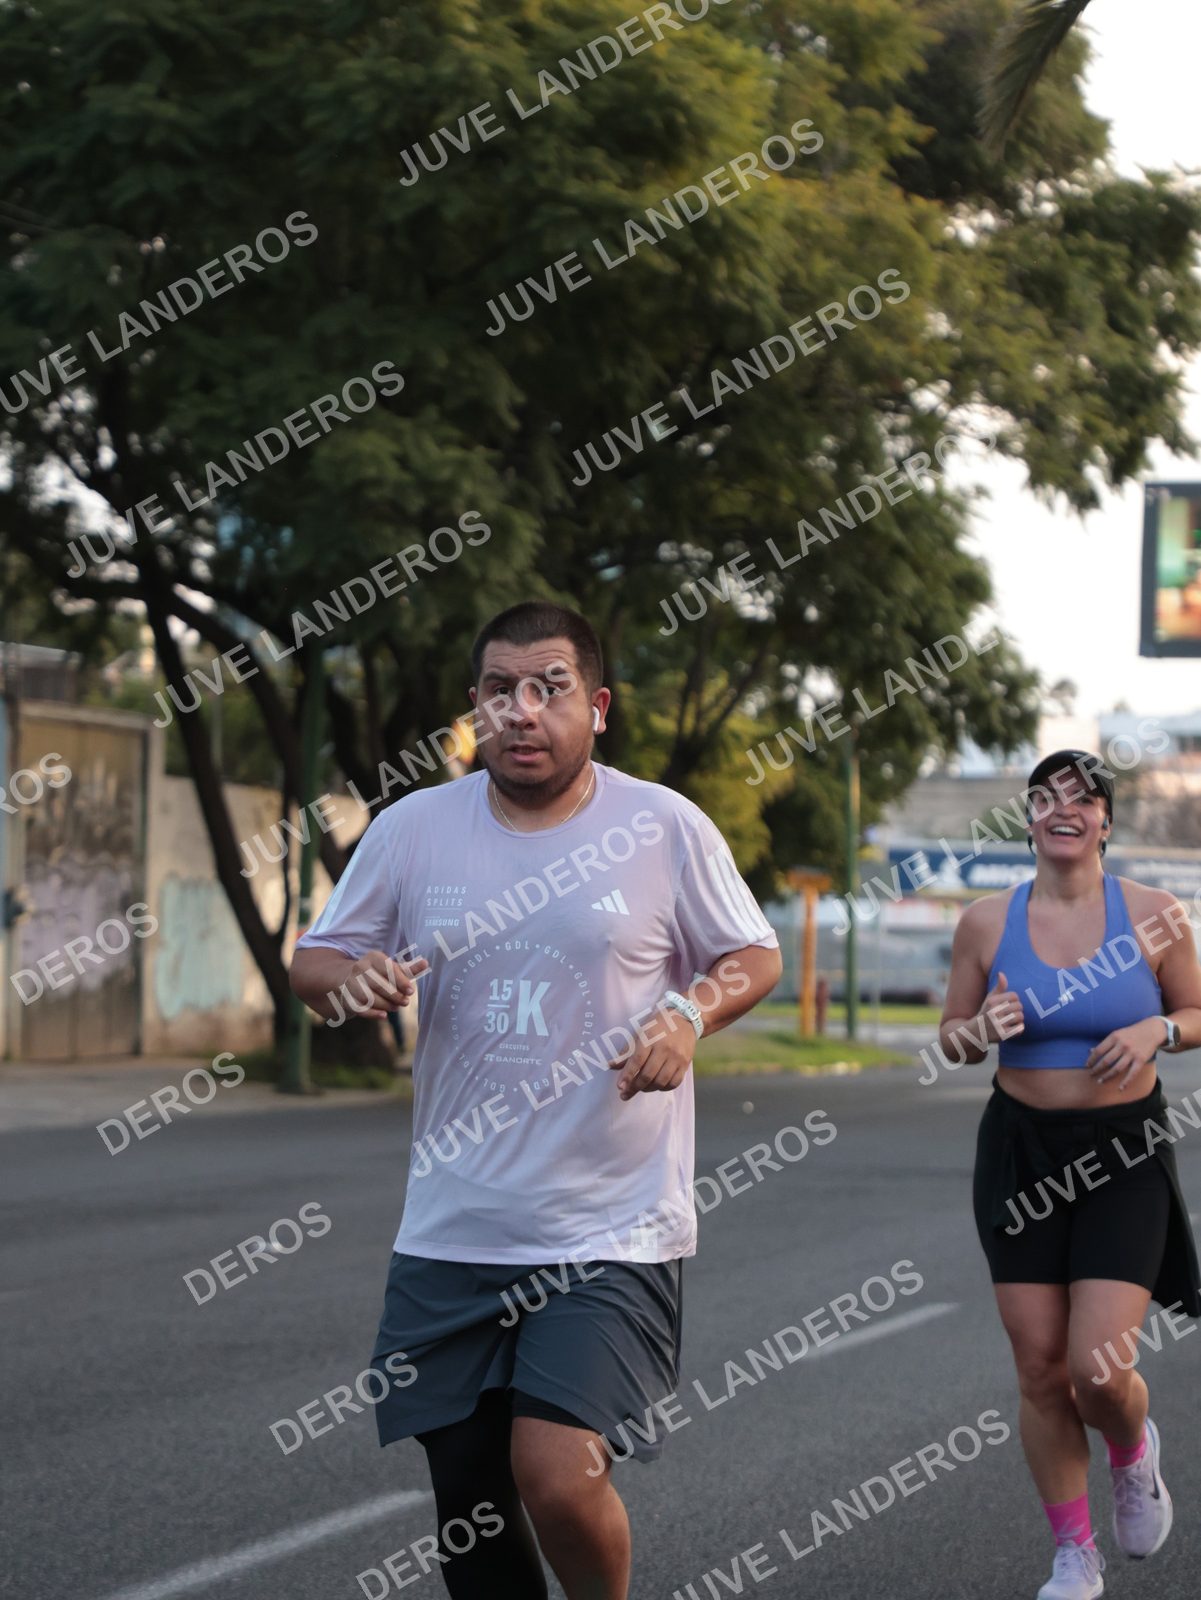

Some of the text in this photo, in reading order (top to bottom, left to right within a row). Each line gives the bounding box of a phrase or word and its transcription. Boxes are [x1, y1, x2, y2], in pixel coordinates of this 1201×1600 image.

[426, 885, 467, 894] ADIDAS
[426, 898, 463, 906] SPLITS
[488, 978, 513, 1001] 15
[516, 979, 551, 1037] K
[484, 1011, 510, 1034] 30
[496, 1055, 543, 1065] BANORTE
